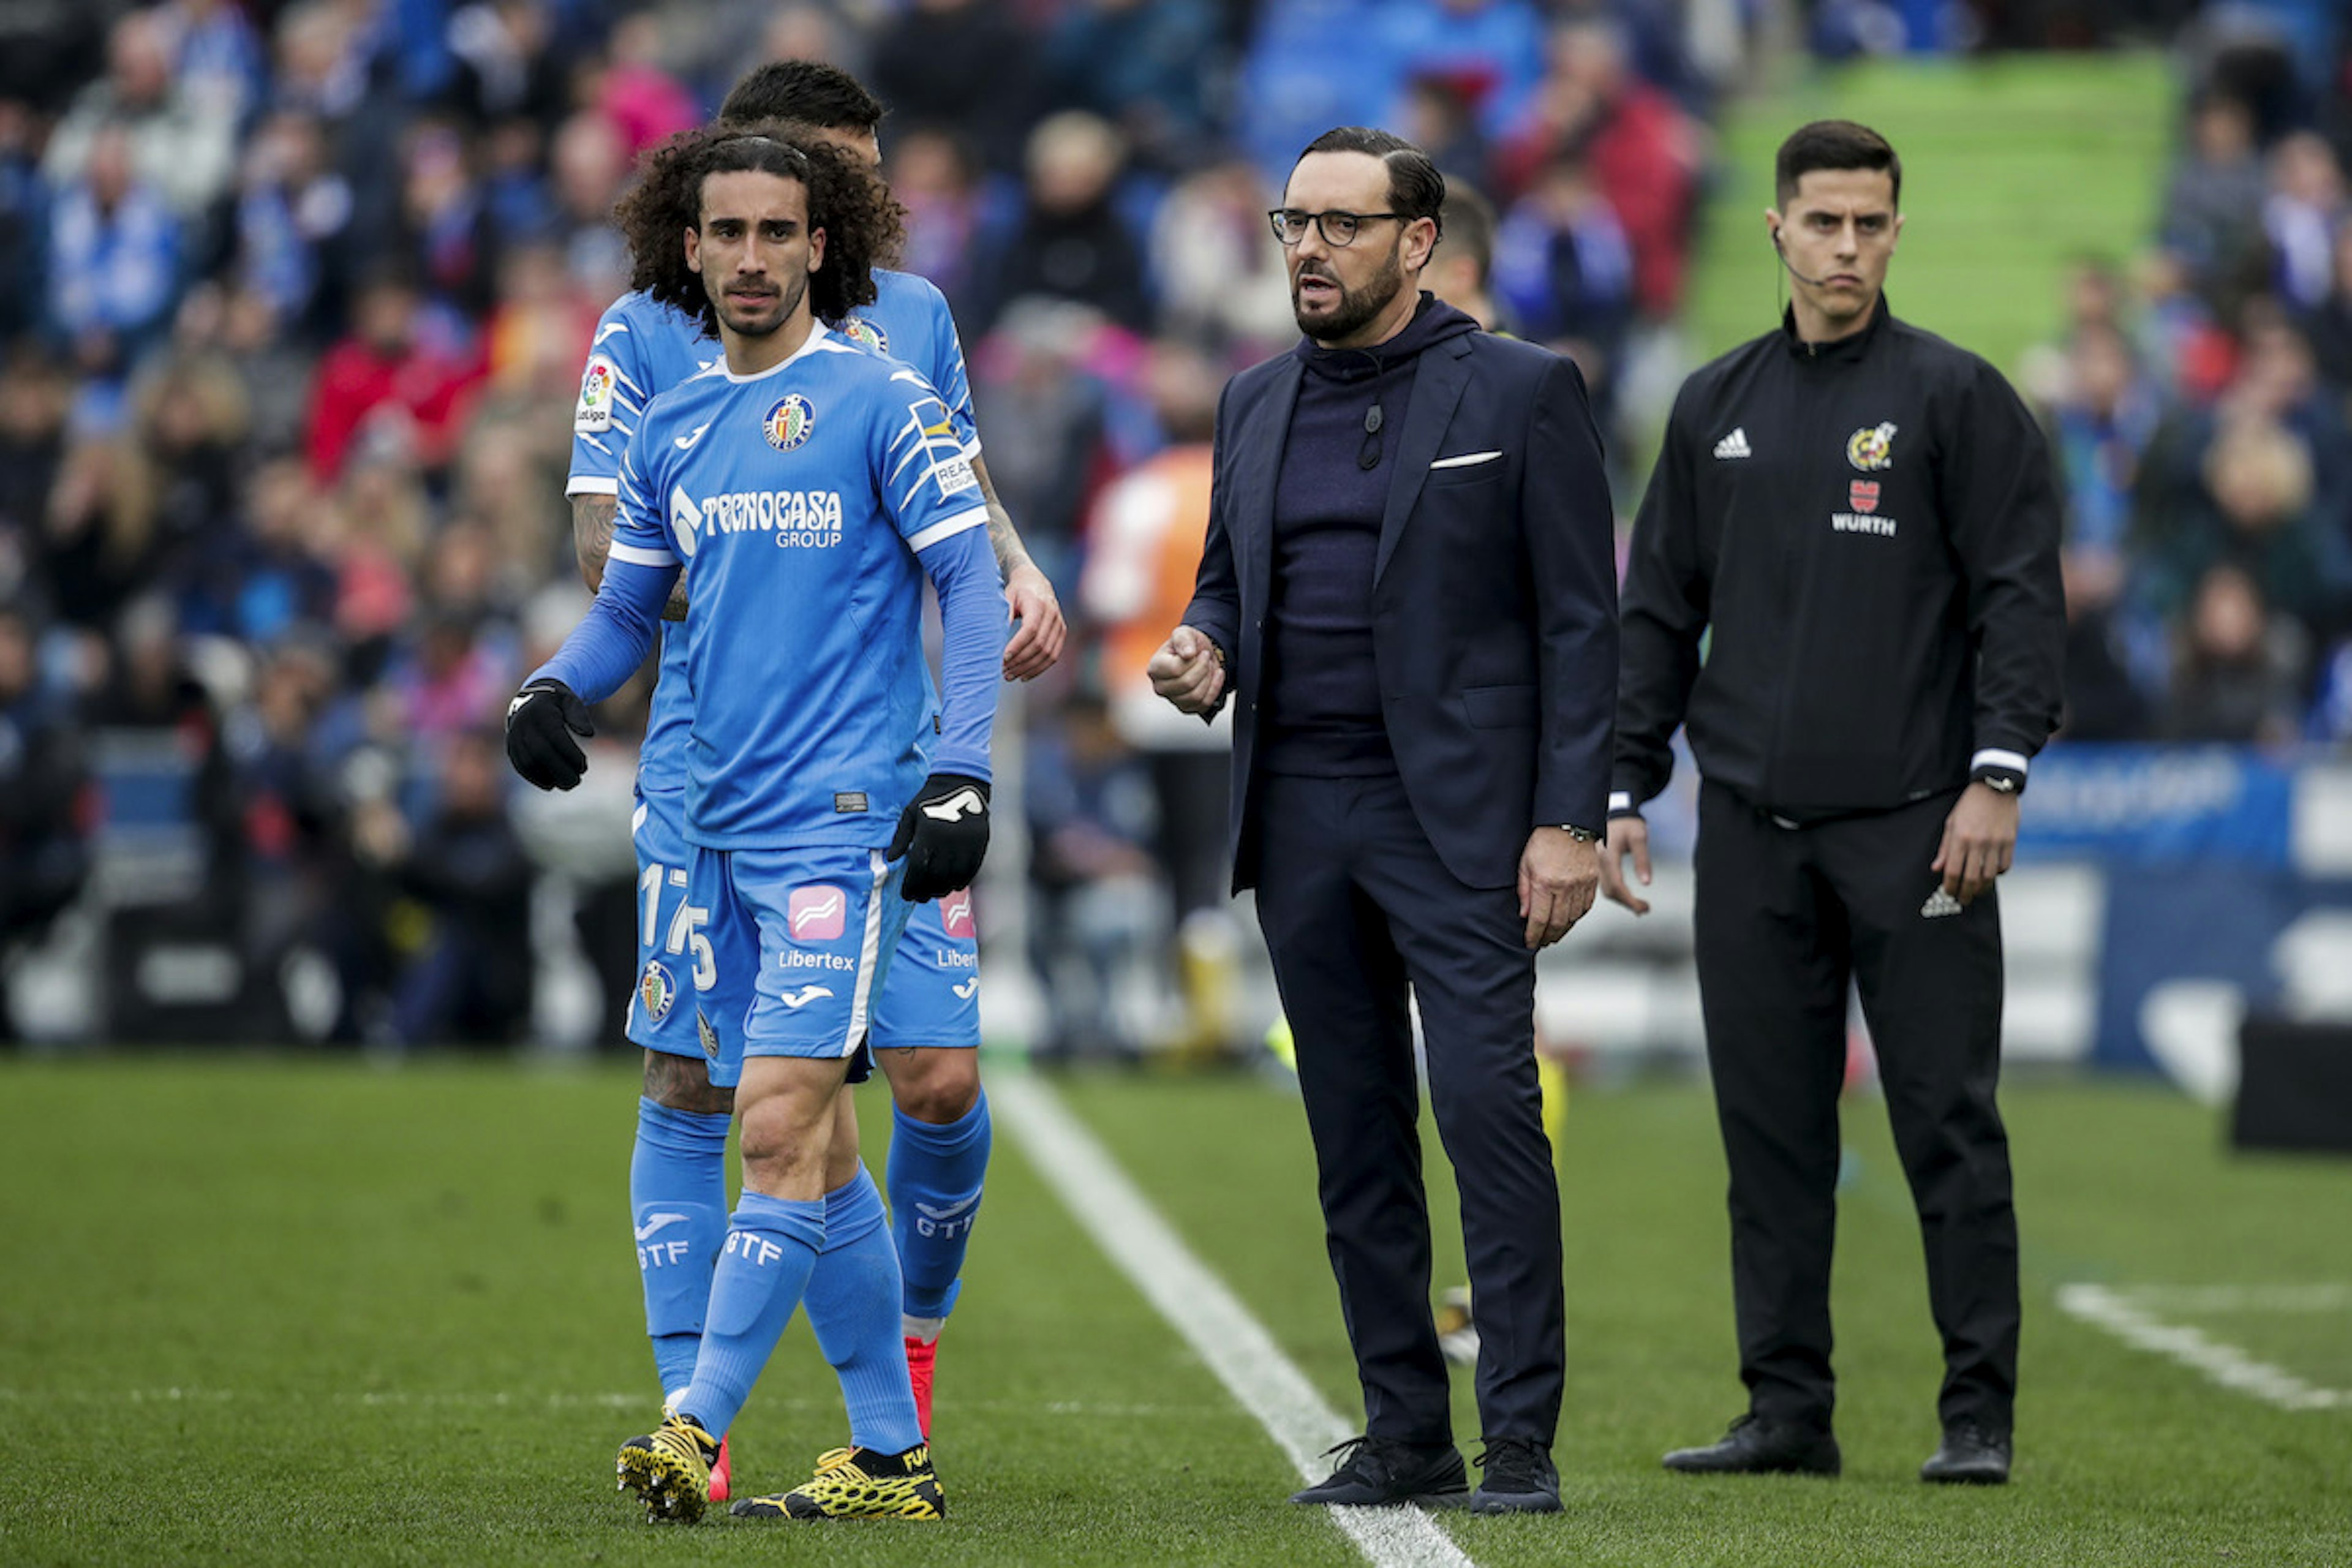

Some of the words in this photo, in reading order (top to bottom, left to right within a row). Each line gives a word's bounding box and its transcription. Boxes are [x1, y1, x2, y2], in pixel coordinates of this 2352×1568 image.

[701, 491, 842, 536] TECNOCASA
[775, 531, 842, 548] GROUP
[779, 950, 854, 971] Libertex
[638, 1240, 688, 1270] GTF
[726, 1231, 782, 1266] GTF
